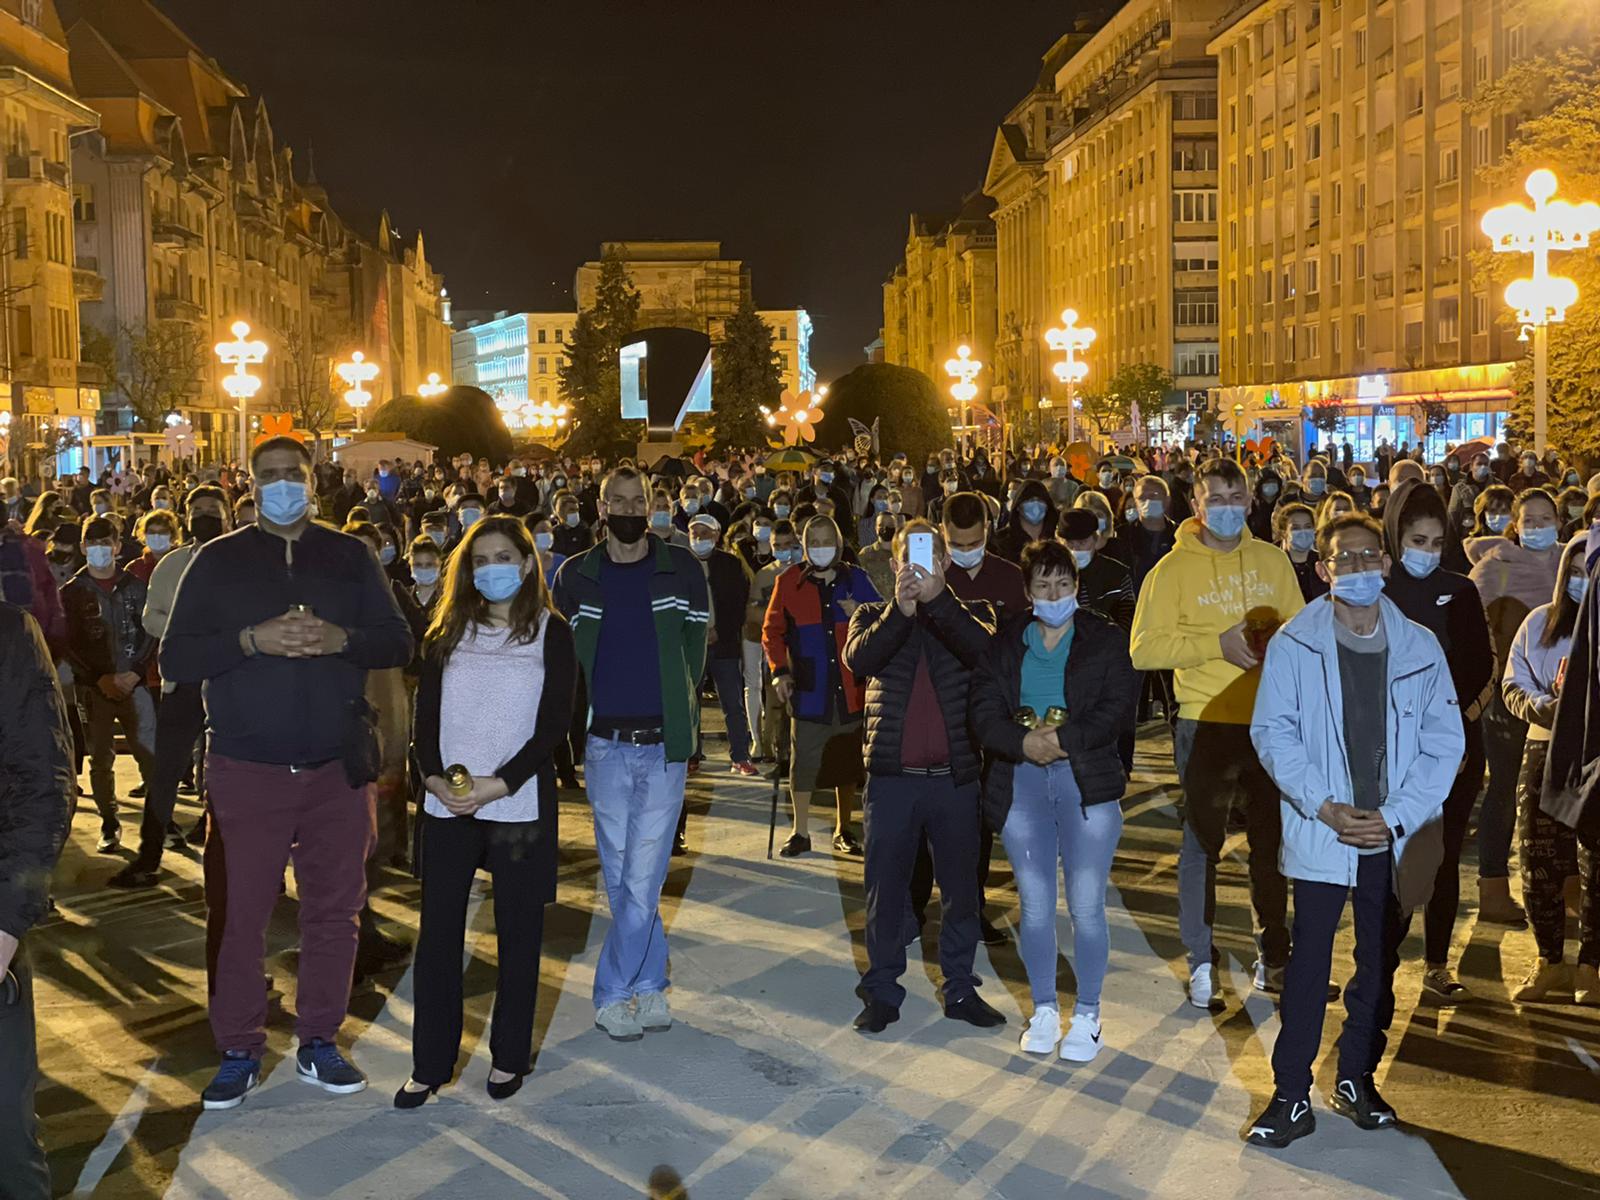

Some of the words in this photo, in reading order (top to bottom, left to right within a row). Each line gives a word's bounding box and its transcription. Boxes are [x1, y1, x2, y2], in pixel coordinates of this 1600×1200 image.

[1209, 576, 1224, 590] IF
[1228, 569, 1258, 588] NOT
[1198, 589, 1233, 606] NOW
[1219, 598, 1254, 615] WHE
